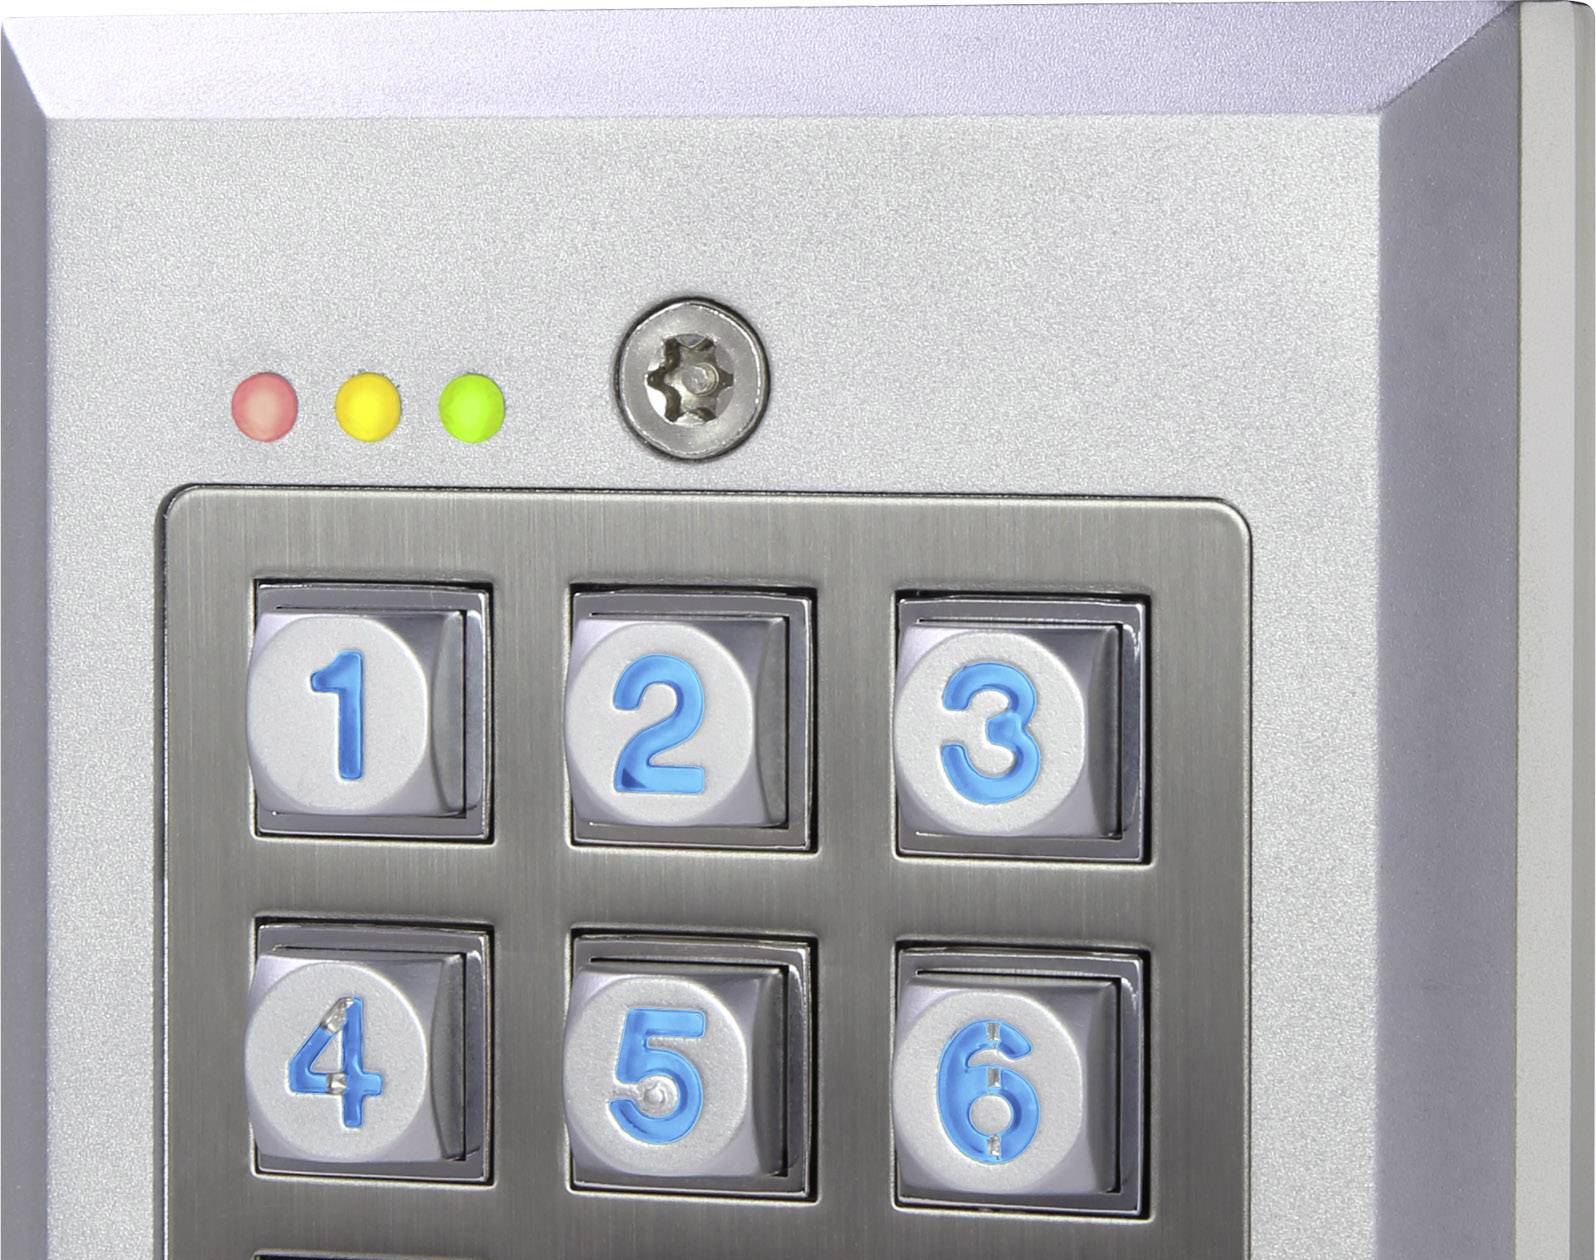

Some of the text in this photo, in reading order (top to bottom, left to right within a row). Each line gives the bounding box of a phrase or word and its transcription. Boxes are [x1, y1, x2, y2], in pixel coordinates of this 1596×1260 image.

[311, 652, 364, 780] 1
[613, 655, 705, 793] 2
[941, 663, 1041, 804] 3
[288, 997, 384, 1128] 4
[610, 1008, 705, 1143] 5
[938, 1020, 1040, 1164] 6
